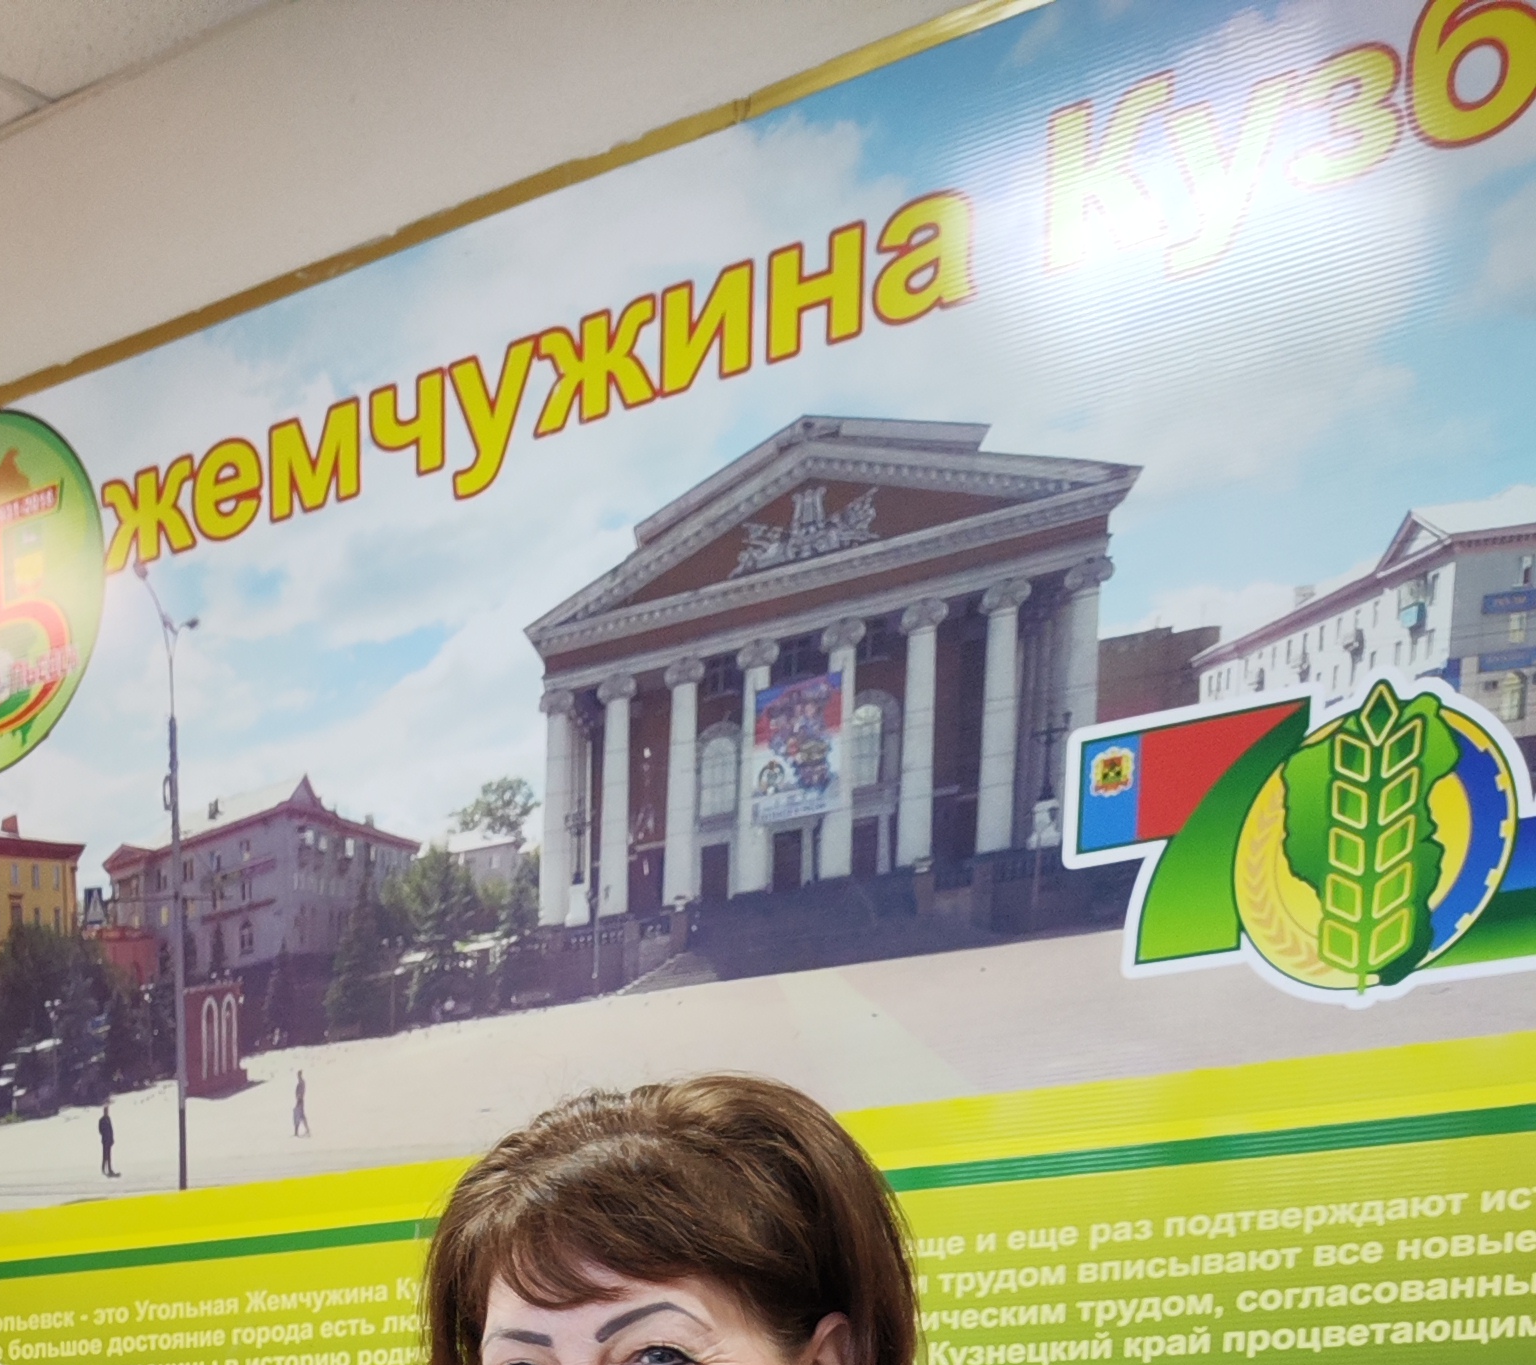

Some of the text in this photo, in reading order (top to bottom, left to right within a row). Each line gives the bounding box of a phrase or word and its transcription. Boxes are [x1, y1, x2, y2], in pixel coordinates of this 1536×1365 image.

[975, 1232, 997, 1253] и
[1007, 1225, 1079, 1250] еще
[1089, 1219, 1154, 1251] раз
[1164, 1192, 1469, 1240] подтверждают
[937, 1264, 1067, 1298] трудом
[1077, 1247, 1303, 1285] вписывают
[1314, 1241, 1385, 1268] все
[1396, 1230, 1536, 1262] новые
[93, 1307, 130, 1326] это
[135, 1296, 239, 1323] Угольная
[245, 1282, 389, 1313] Жемчужина
[1076, 1293, 1224, 1328] трудом,
[8, 1338, 103, 1362] большое
[106, 1328, 226, 1357] достояние
[231, 1321, 314, 1349] города
[320, 1317, 376, 1339] есть
[1123, 1326, 1212, 1364] край
